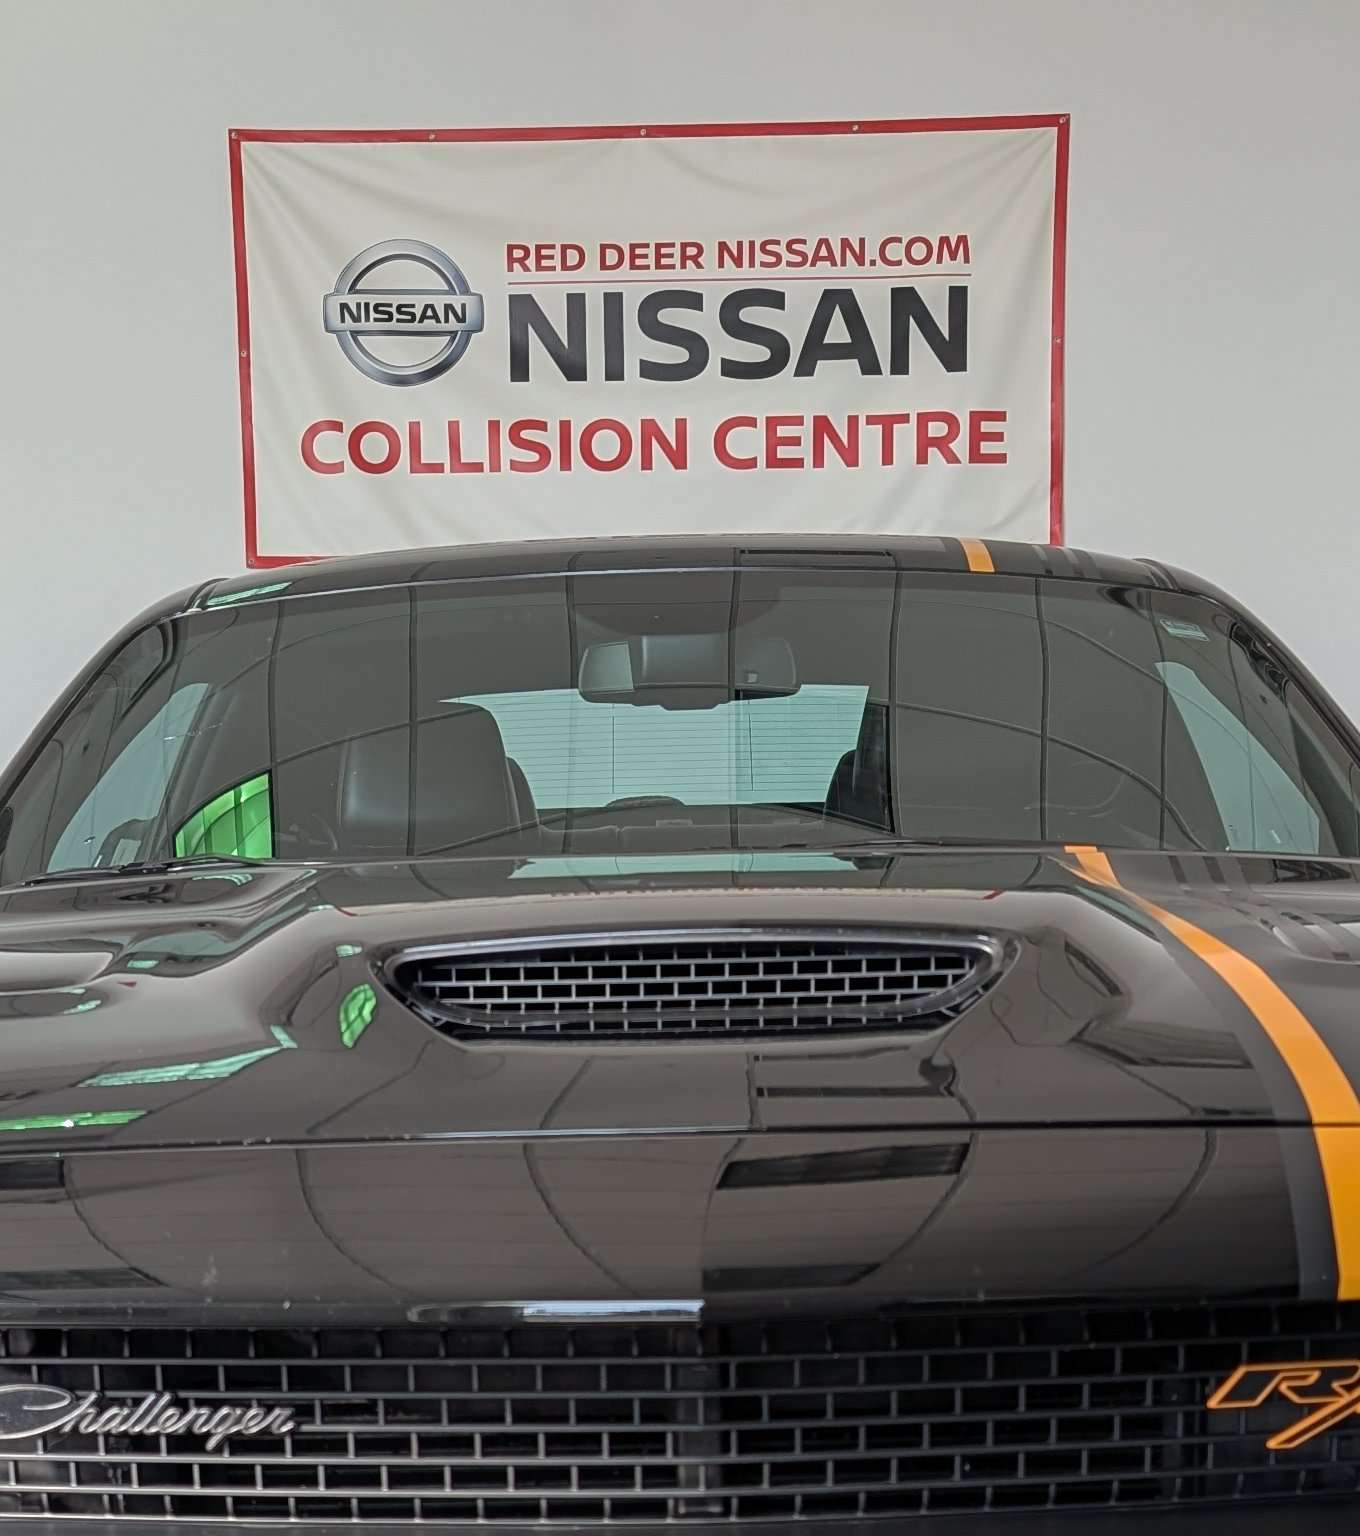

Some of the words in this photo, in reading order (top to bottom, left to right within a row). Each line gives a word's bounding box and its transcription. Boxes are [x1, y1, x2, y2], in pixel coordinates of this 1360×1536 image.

[506, 243, 586, 273] RED
[599, 241, 705, 271] DEER
[717, 235, 972, 269] NISSAN.COM
[338, 300, 469, 327] NISSAN
[508, 285, 970, 384] NISSAN
[300, 417, 690, 476] COLLISION
[712, 410, 1010, 471] CENTRE
